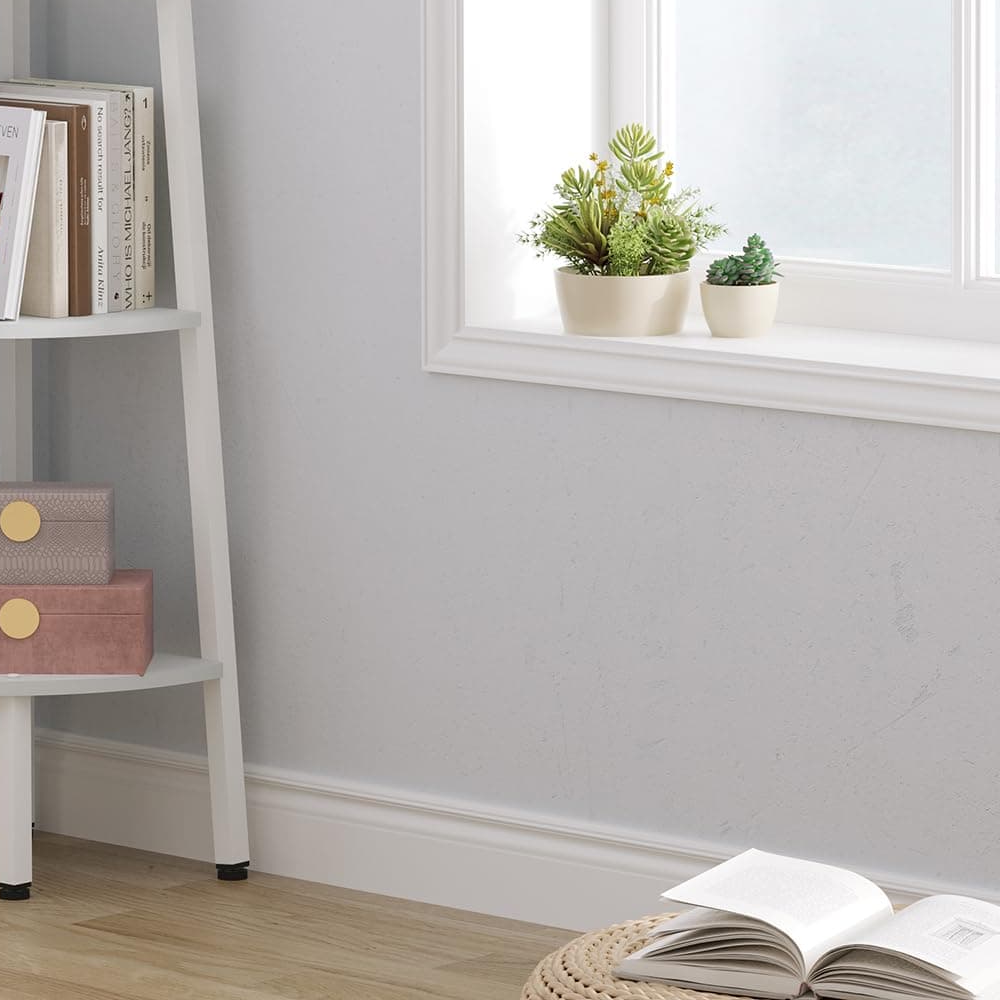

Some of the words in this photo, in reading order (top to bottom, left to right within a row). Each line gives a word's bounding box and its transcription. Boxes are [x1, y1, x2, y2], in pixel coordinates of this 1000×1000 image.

[97, 107, 104, 123] No
[124, 108, 132, 161] JANG?
[124, 166, 133, 241] MICHAEL
[125, 244, 133, 260] IS
[125, 264, 133, 309] WHO
